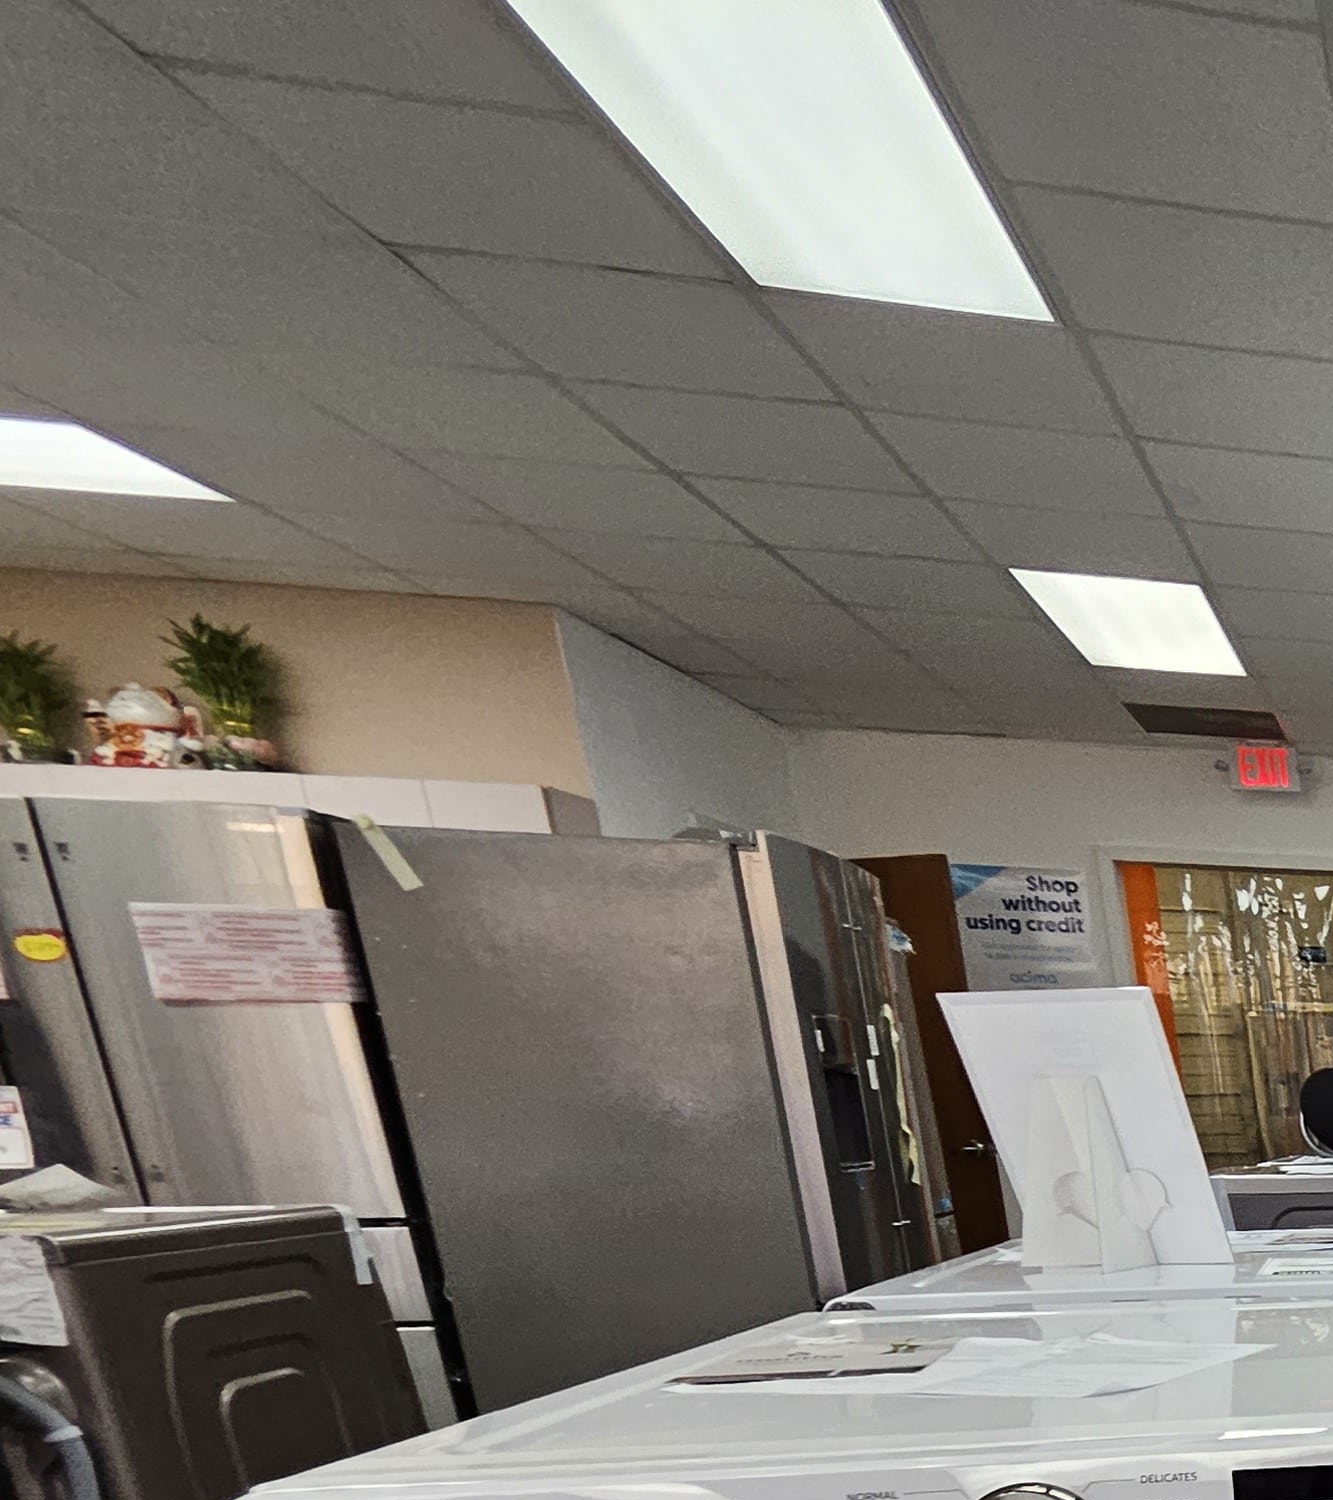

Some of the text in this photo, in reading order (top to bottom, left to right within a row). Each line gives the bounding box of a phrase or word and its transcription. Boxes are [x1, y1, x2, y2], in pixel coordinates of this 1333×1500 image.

[1237, 745, 1289, 788] EXIT
[1025, 875, 1079, 897] Shop
[1001, 895, 1082, 914] without
[965, 914, 1085, 935] using credit
[1009, 971, 1058, 984] acima
[1140, 1472, 1197, 1484] DELICATES
[846, 1491, 900, 1500] NORMAL
